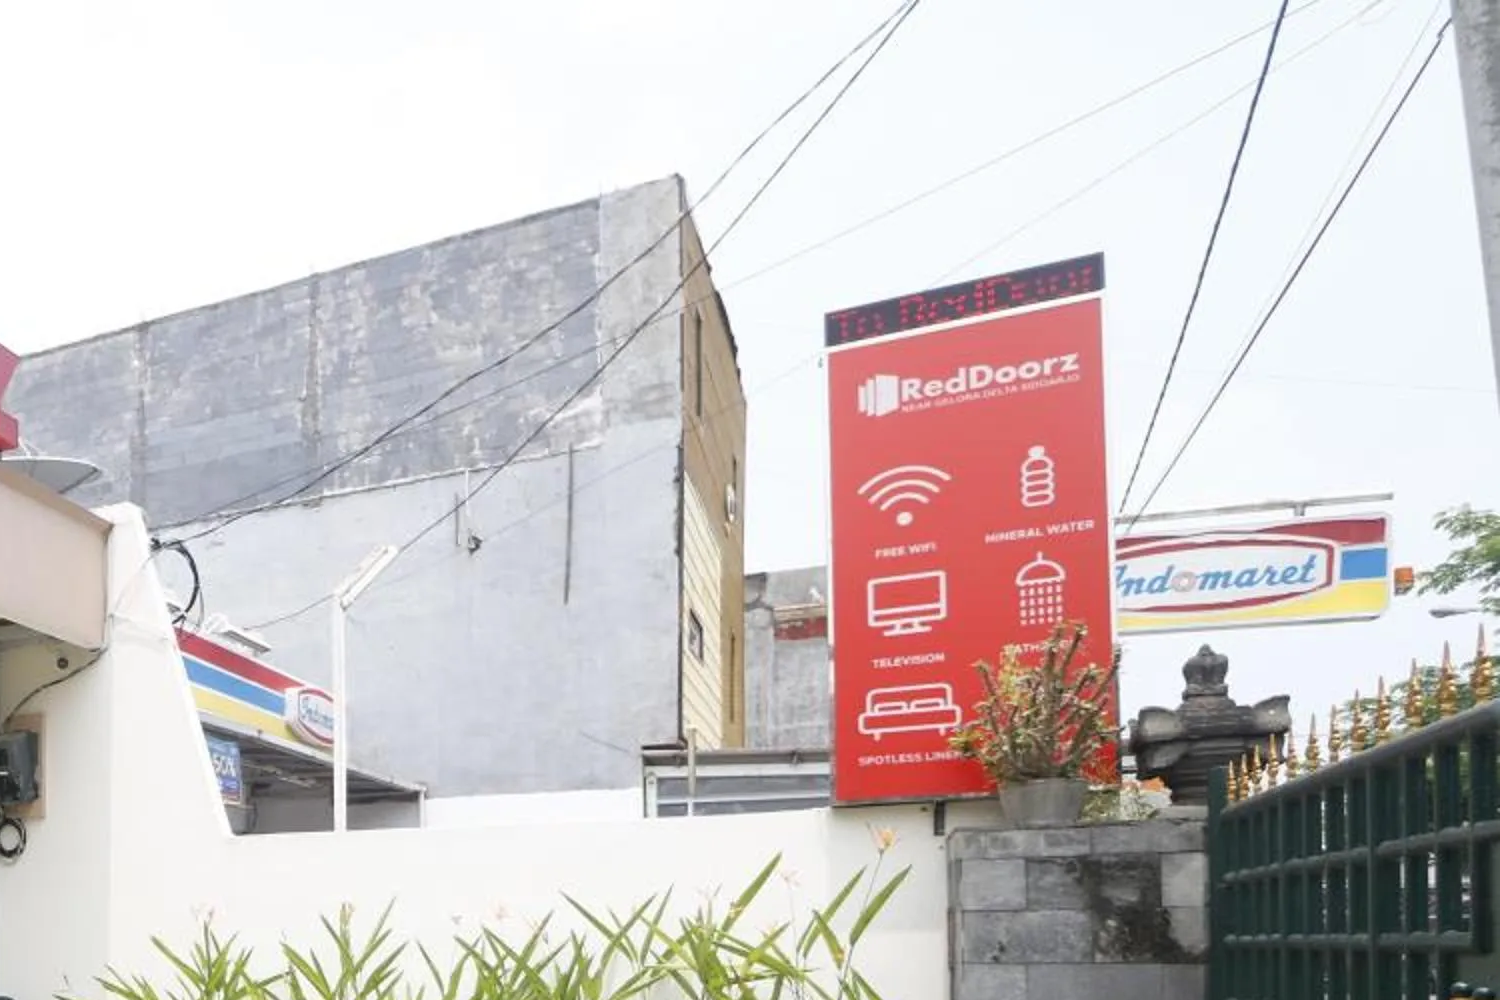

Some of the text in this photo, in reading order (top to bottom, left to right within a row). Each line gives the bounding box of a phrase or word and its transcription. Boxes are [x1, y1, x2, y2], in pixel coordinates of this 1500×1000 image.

[900, 352, 1080, 402] RedDoorz
[985, 519, 1095, 544] MINERAL WATER
[875, 541, 936, 559] FREE WIFI
[1115, 554, 1317, 597] Indomaret
[872, 652, 945, 669] TELEVISION
[858, 752, 922, 767] SPOTLESS
